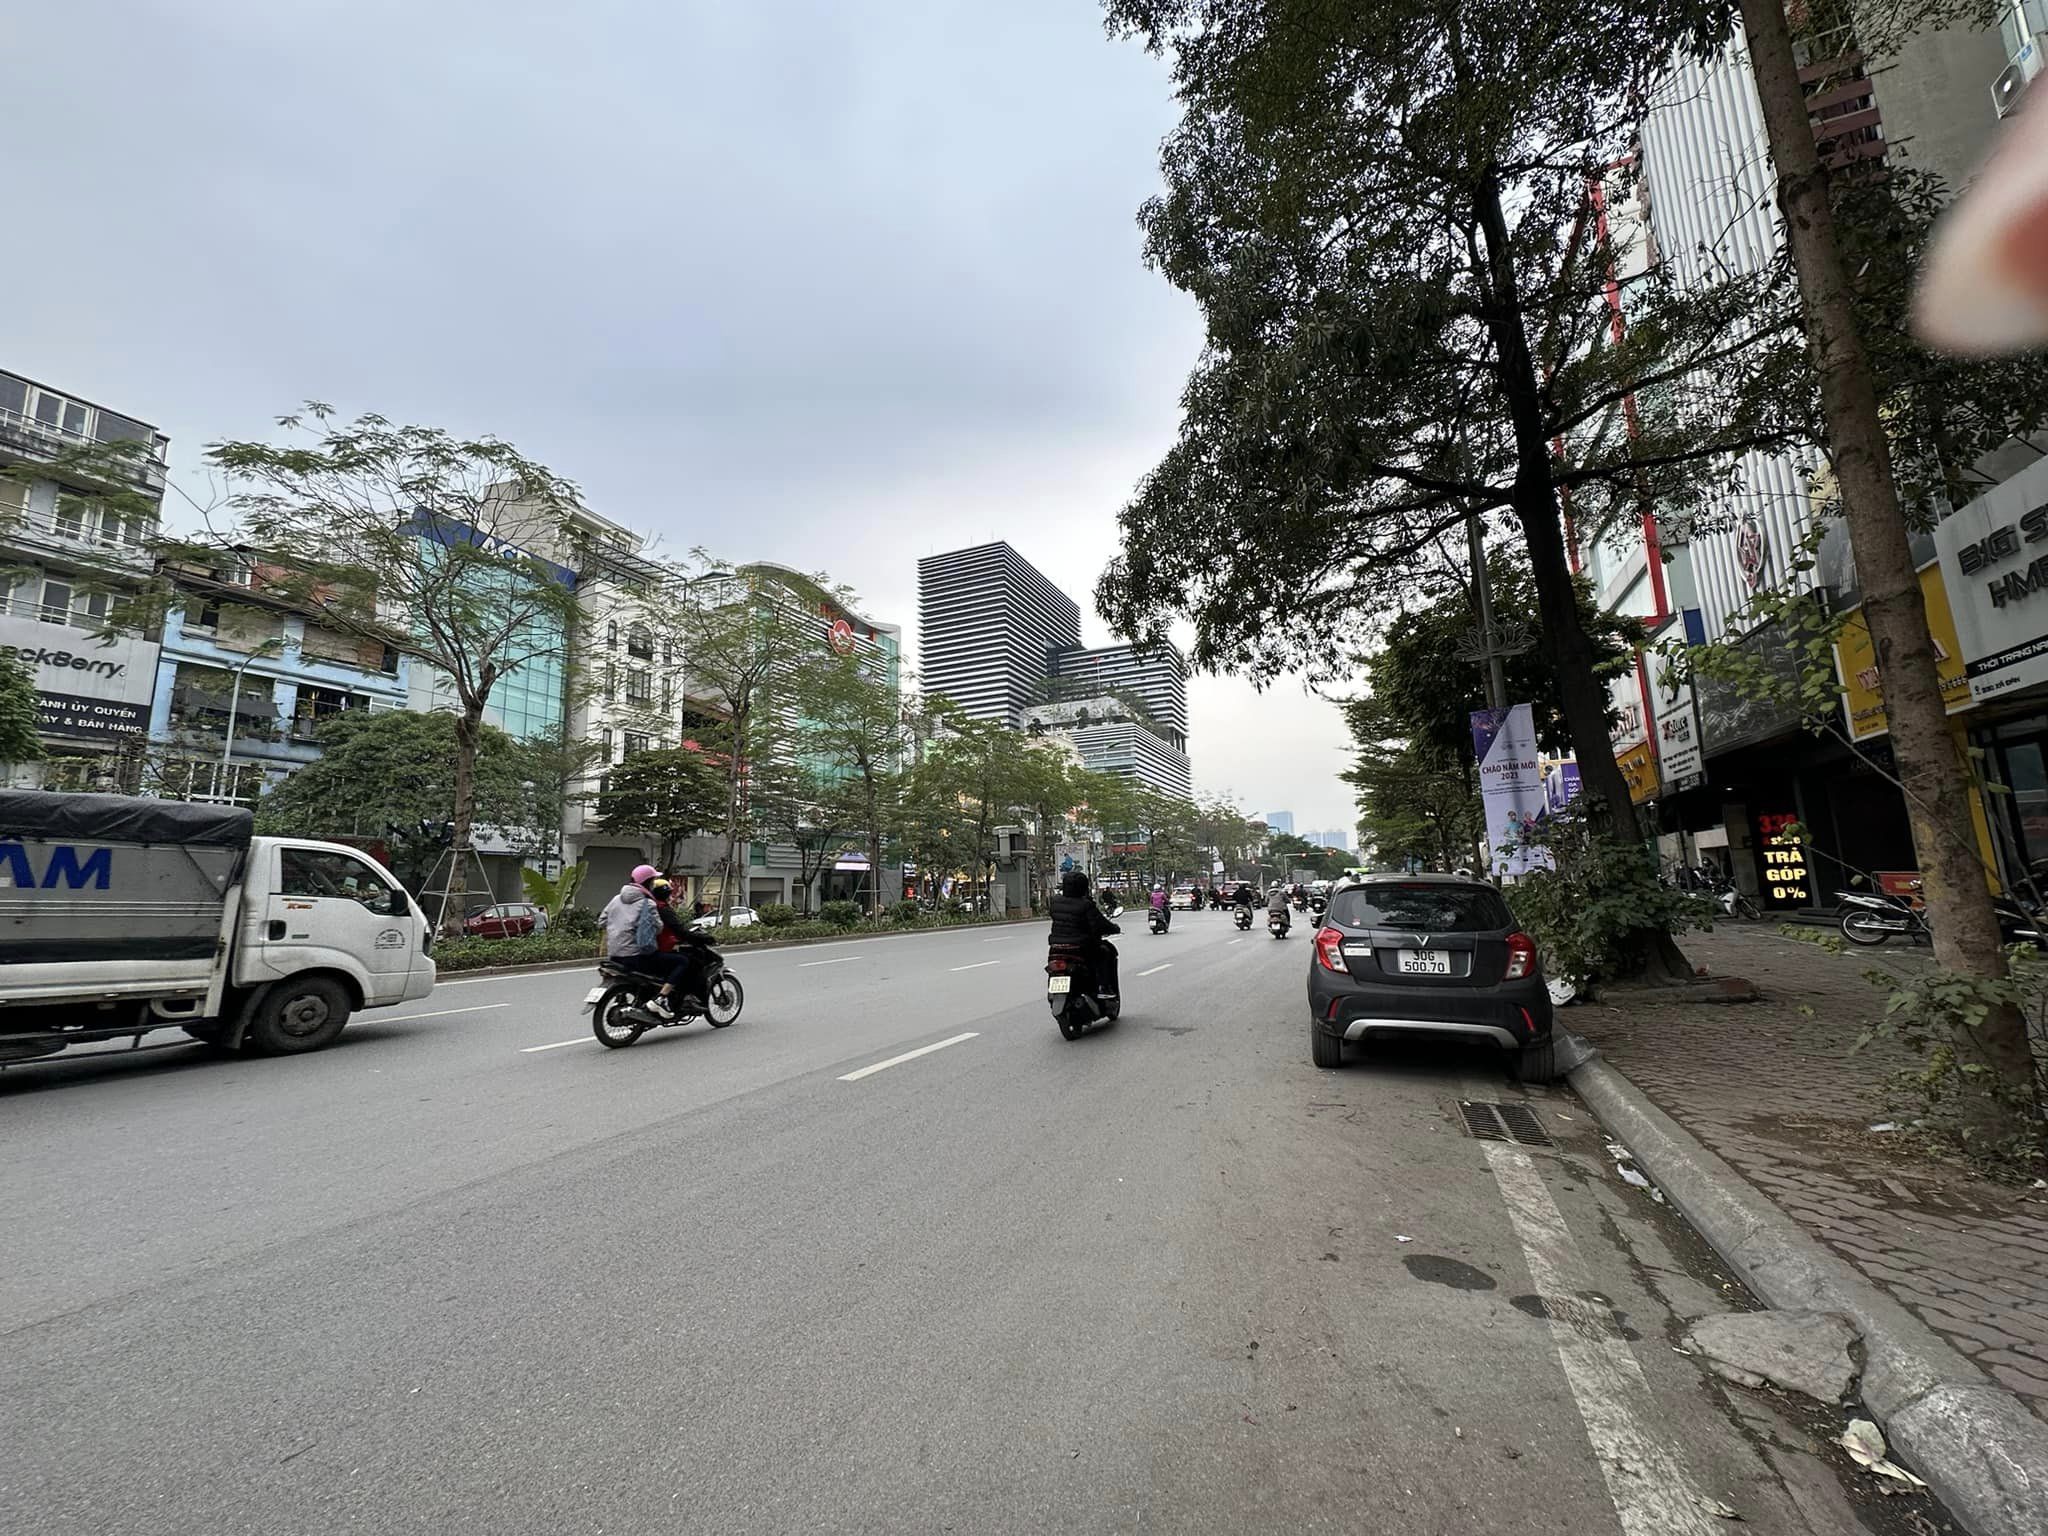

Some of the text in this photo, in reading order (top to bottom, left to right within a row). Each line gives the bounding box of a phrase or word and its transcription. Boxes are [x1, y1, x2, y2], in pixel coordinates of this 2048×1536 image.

[1957, 503, 2048, 576] BIG S
[63, 717, 73, 726] &
[78, 717, 105, 729] BÁN
[1482, 764, 1502, 775] CHÀO
[1502, 761, 1520, 772] NĂM
[1520, 760, 1537, 770] MỚI
[1501, 772, 1519, 780] 2023
[1763, 847, 1804, 864] TRẢ
[1766, 865, 1807, 881] GÓP
[1773, 886, 1807, 899] 0%
[1413, 950, 1435, 961] 30G
[1404, 961, 1445, 973] 500.70
